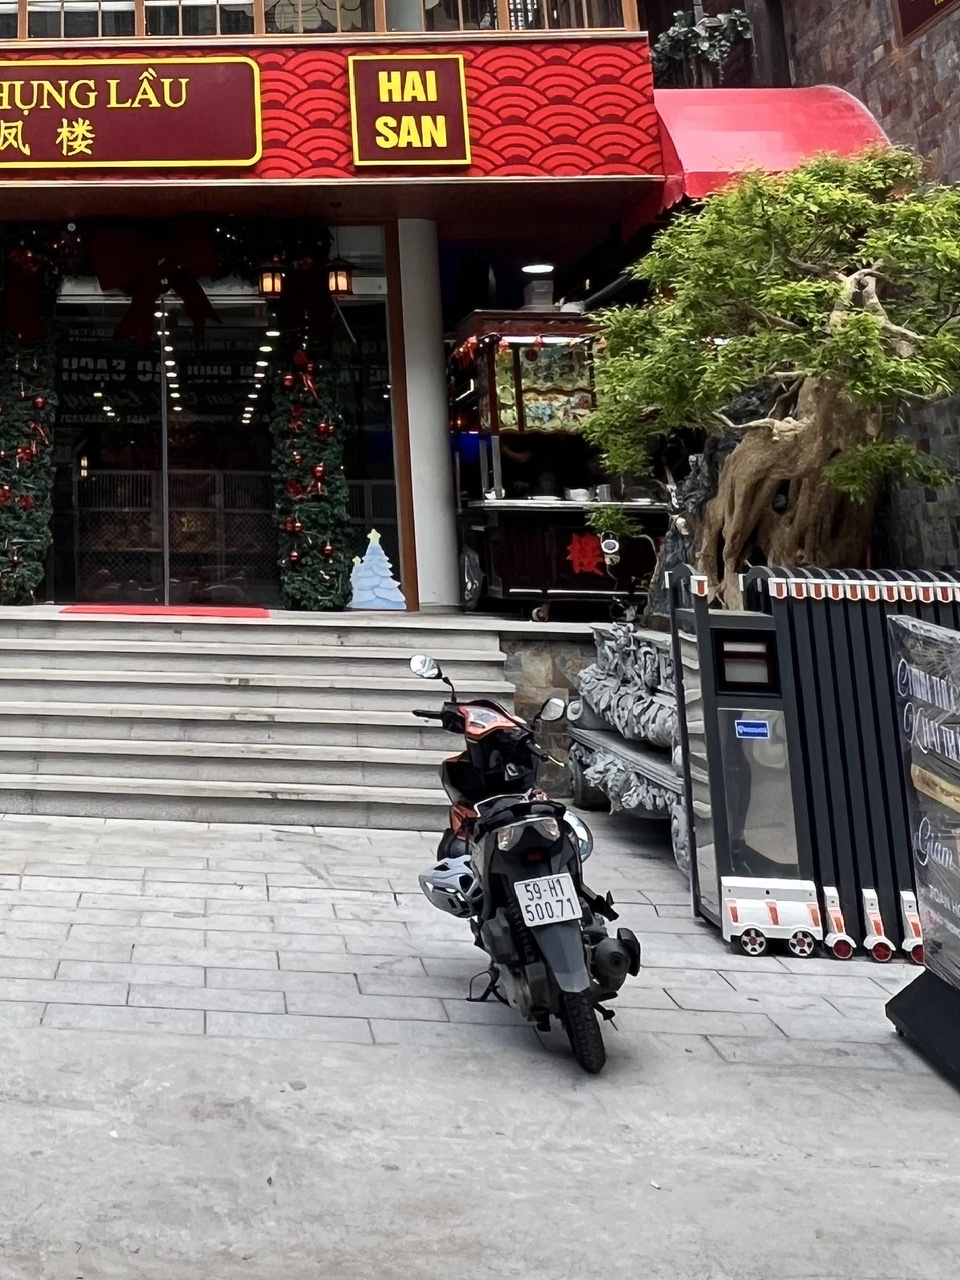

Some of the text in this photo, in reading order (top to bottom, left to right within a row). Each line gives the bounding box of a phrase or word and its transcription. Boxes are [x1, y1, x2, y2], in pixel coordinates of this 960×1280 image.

[106, 68, 189, 109] LẦU
[377, 70, 438, 103] HAI
[375, 115, 448, 149] SAN
[524, 878, 565, 901] 59-H1
[524, 897, 576, 922] 500.71
